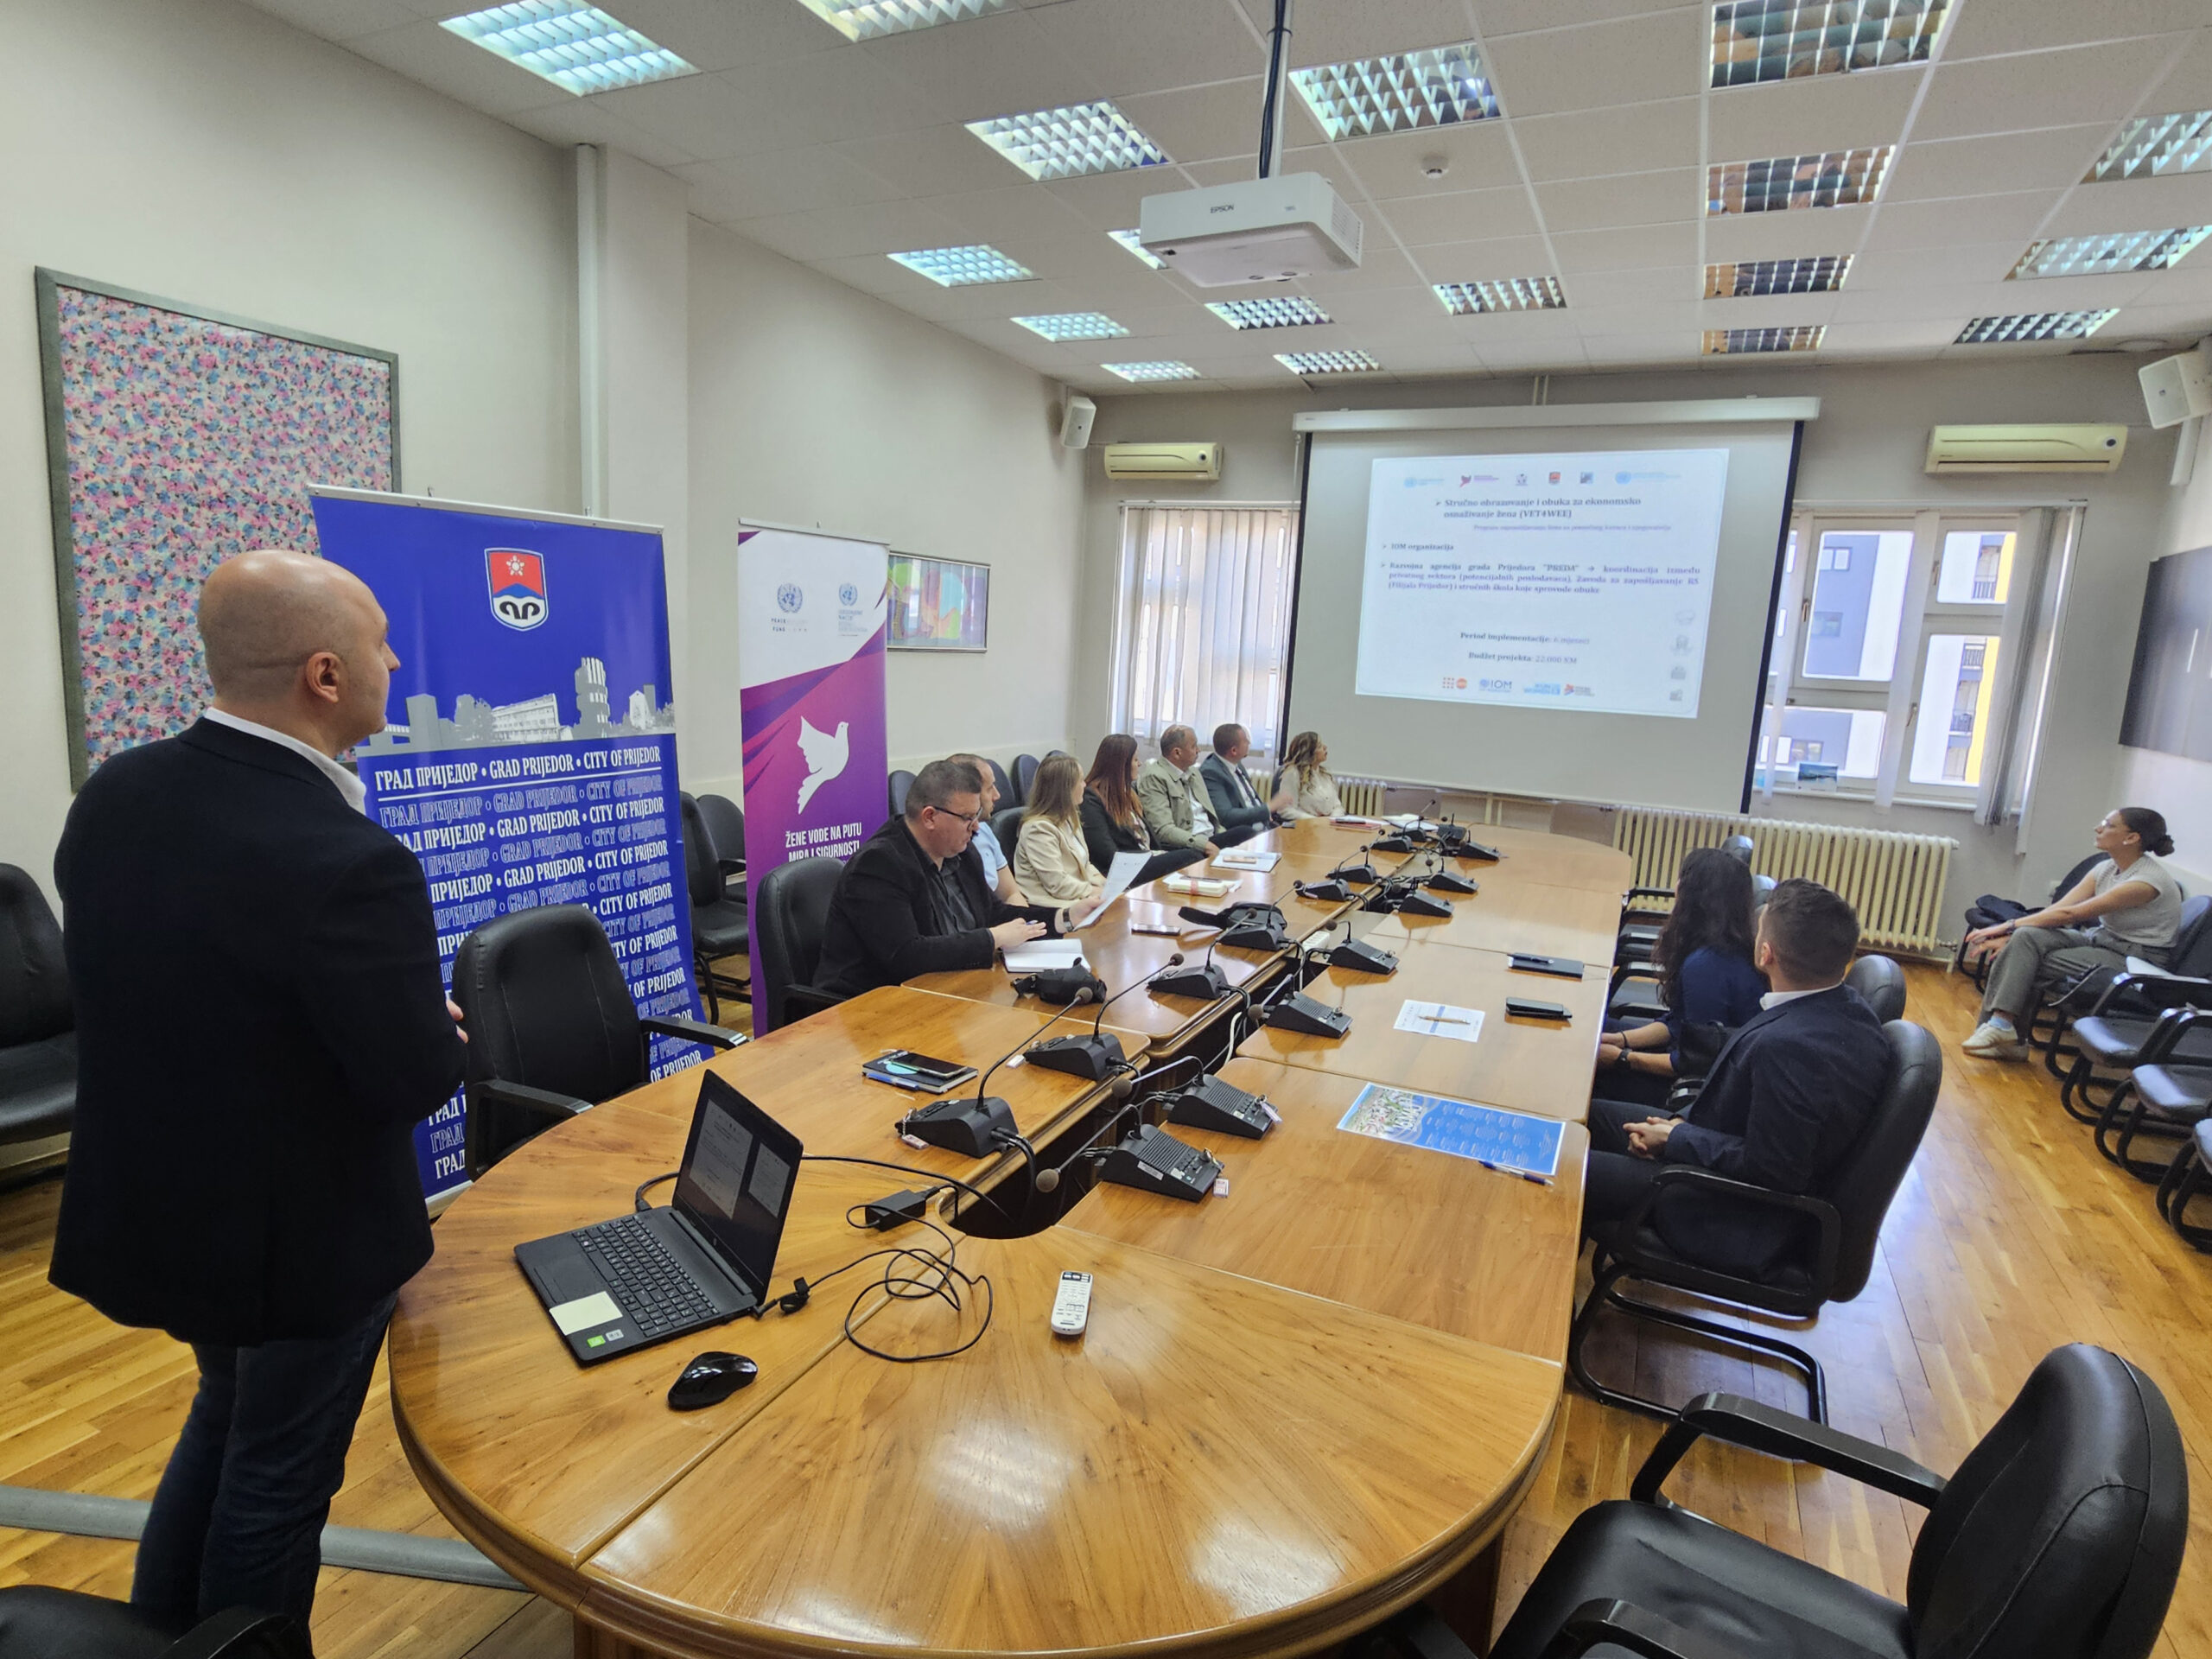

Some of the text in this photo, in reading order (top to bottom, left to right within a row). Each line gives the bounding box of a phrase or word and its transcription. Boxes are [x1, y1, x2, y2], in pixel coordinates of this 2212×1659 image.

[1210, 204, 1234, 213] EPSON
[374, 746, 661, 791] ГРАД ПРИЈЕДОР GRAD PRIJEDOR CITY OF PRIJEDOR
[493, 790, 524, 813] GRAD
[587, 780, 611, 801] CITY
[394, 796, 664, 853] АД ПРИЈЕДОР GRAD PRIJEDOR CITY OF PRIJEDOR
[785, 822, 861, 848] ŽENE VODE NA PUTU
[500, 841, 531, 863] GRAD
[592, 826, 616, 847] CITY
[788, 849, 810, 862] MIRA
[816, 840, 860, 858] SIGURNOSTI
[430, 839, 669, 903] ПРИЈЕДОР GRAD PRIJEDOR CITY OF PRIJEDOR
[600, 882, 673, 916] CITY OF PRIJEDOR
[611, 925, 678, 959] TY OF PRIJEDOR
[633, 979, 645, 999] OF
[647, 967, 686, 993] PRIJEDOR
[650, 1067, 662, 1083] OF
[430, 1122, 465, 1154] ГРАД
[435, 1149, 465, 1179] ГРАД
